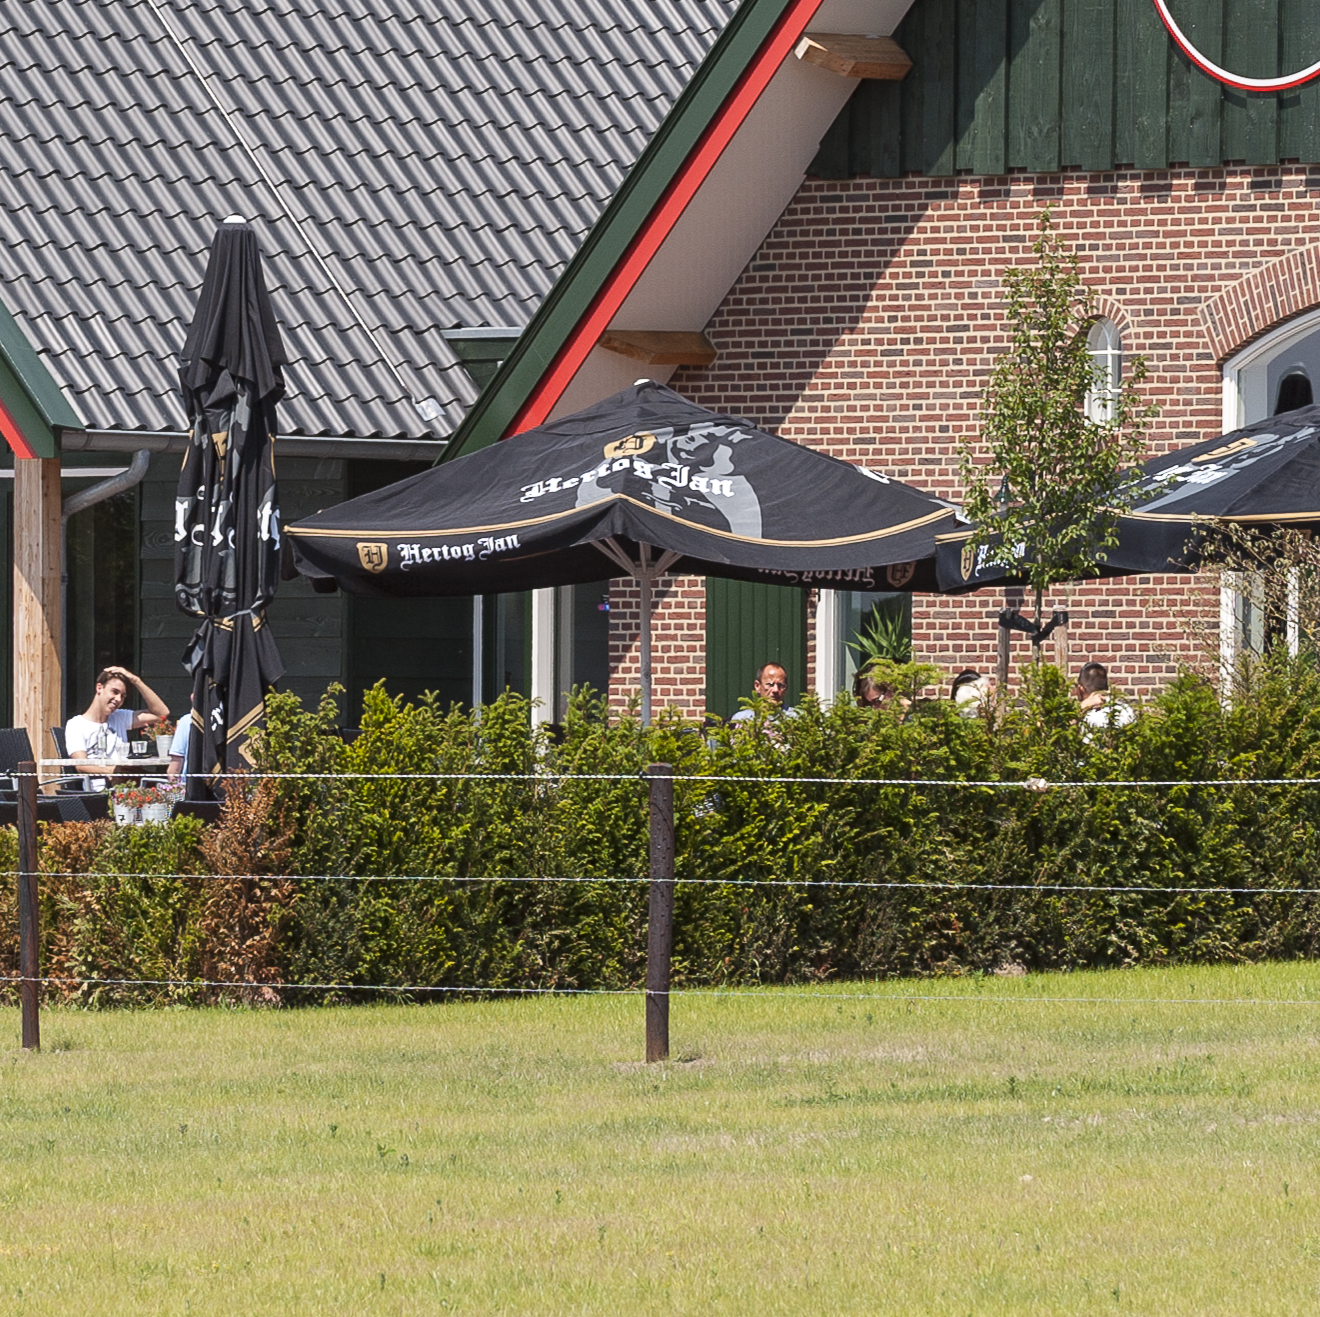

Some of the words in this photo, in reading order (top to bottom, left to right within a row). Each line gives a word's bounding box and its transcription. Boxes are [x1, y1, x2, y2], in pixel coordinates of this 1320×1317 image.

[520, 458, 654, 502] Hertog
[657, 462, 734, 497] Jan
[397, 543, 475, 571] Hertog
[477, 534, 521, 560] Jan
